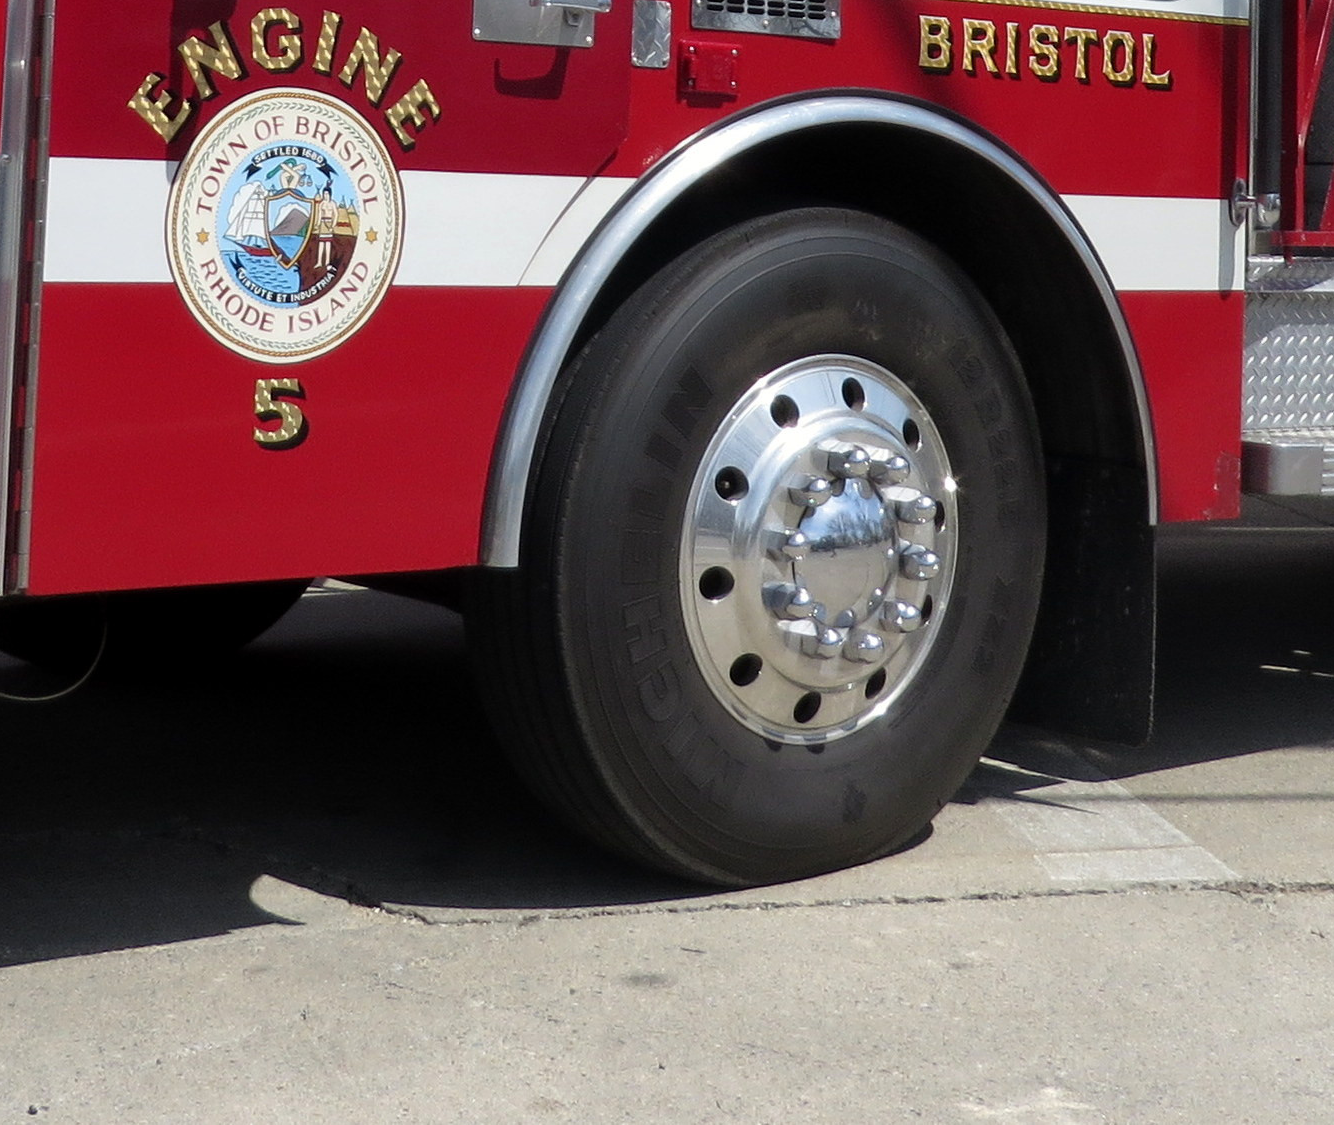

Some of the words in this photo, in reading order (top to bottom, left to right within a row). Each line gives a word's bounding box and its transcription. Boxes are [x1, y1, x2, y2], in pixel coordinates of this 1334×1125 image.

[127, 7, 443, 150] ENGINE
[919, 15, 1172, 86] BRISTOL
[196, 132, 249, 215] TOWN
[254, 115, 285, 141] OF
[294, 114, 380, 215] BRISTOL
[254, 146, 299, 164] SETTLED
[199, 258, 275, 333] RHODE
[287, 260, 369, 334] ISLAND
[275, 294, 287, 303] ET
[253, 377, 306, 447] 5
[622, 363, 749, 809] MICHELIN
